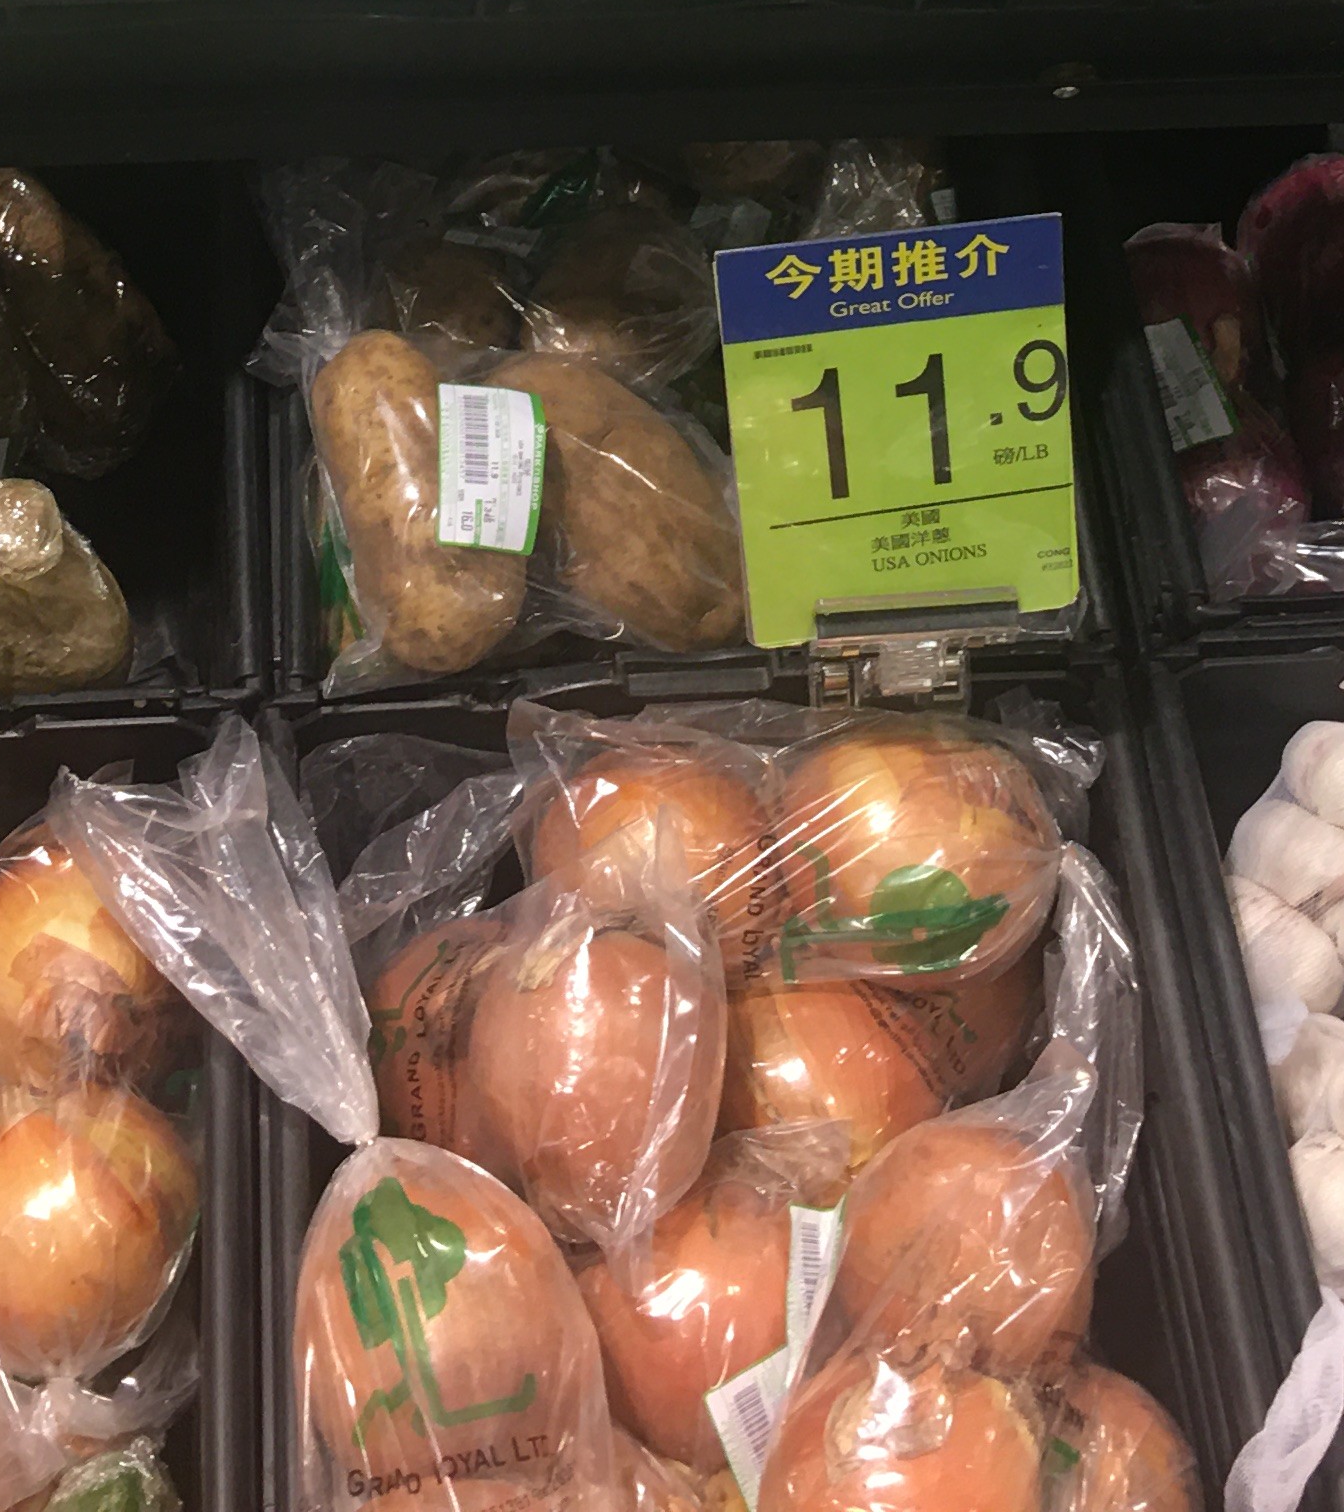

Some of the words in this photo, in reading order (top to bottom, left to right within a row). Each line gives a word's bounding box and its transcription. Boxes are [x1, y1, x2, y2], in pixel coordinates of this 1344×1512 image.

[765, 233, 1010, 300] 今期推介
[830, 297, 891, 319] Great
[897, 290, 955, 310] Offer
[790, 339, 1068, 500] 11.9
[902, 508, 941, 529] 美國
[872, 556, 911, 573] USA
[915, 543, 987, 567] ONIONS
